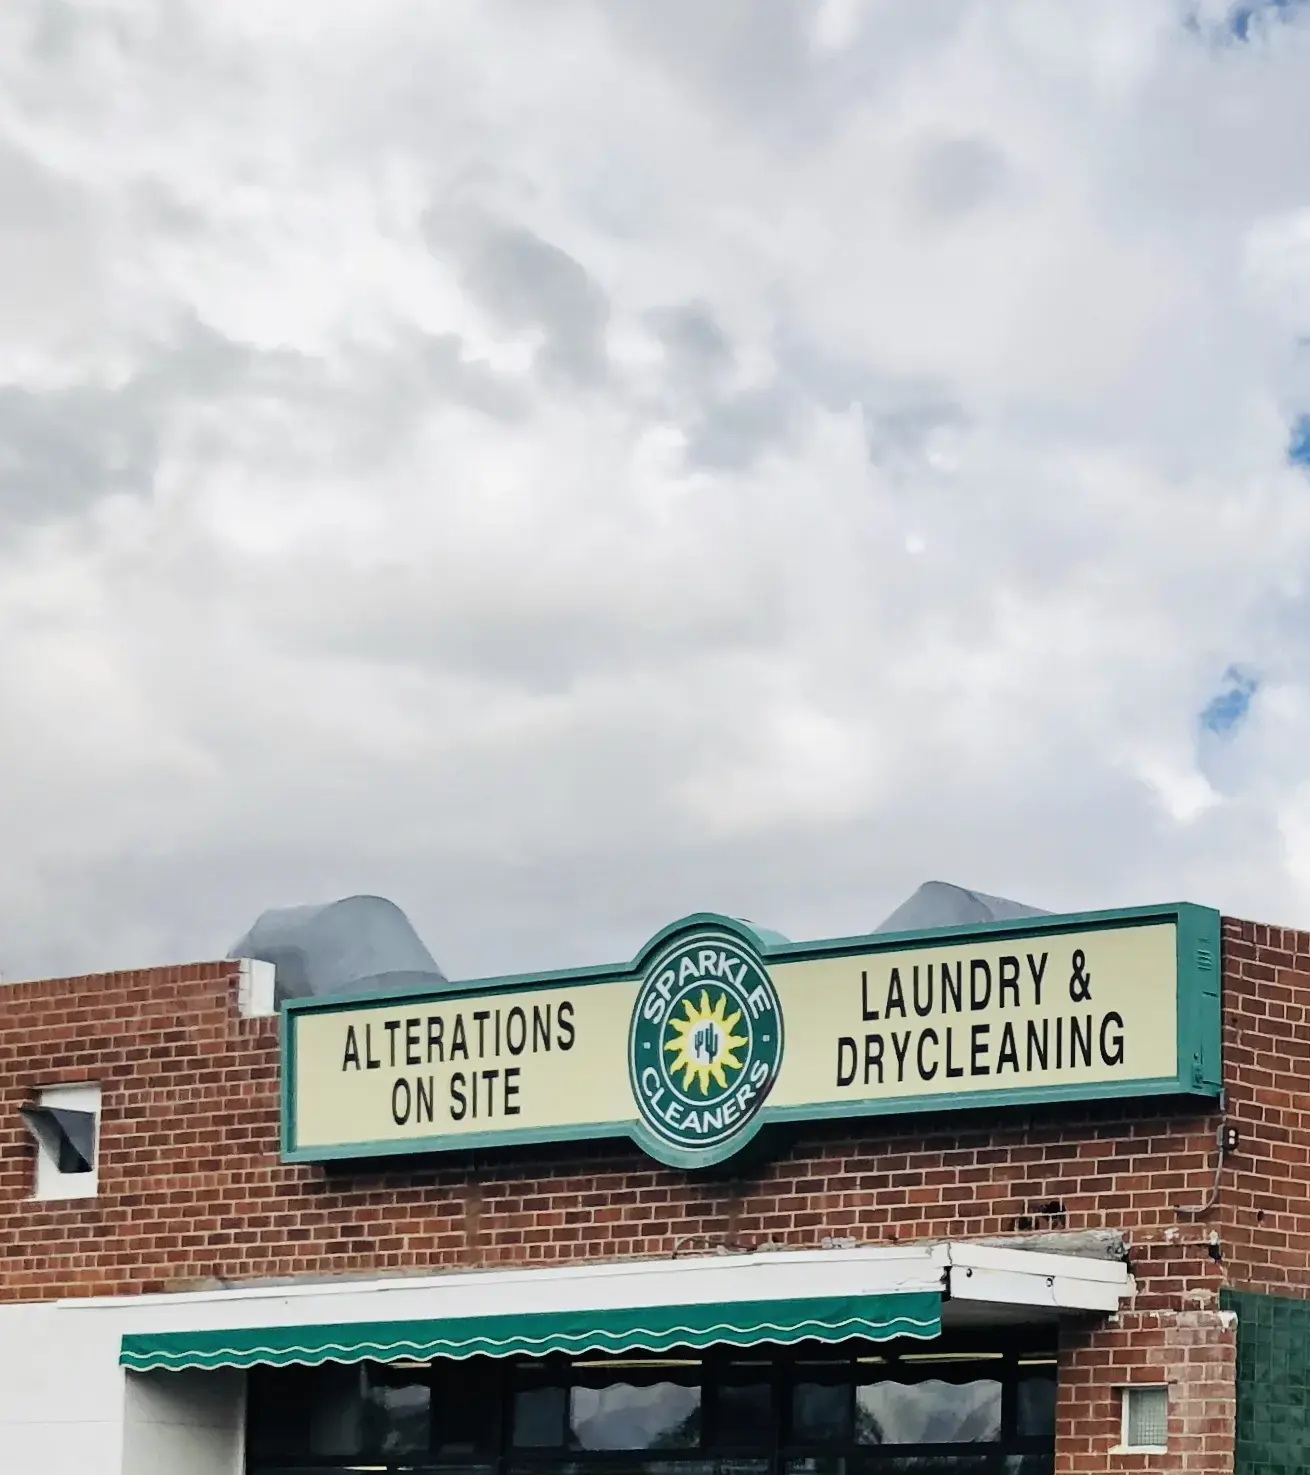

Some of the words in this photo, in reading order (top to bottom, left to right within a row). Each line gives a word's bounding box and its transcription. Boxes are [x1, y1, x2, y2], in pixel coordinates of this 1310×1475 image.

[643, 949, 771, 1025] SPARKLE
[861, 952, 1049, 1021] LAUNDRY
[1069, 949, 1092, 1003] &
[342, 1001, 576, 1072] ALTERATIONS
[836, 1011, 1124, 1087] DRYCLEANING
[391, 1075, 434, 1126] ON
[449, 1067, 521, 1121] SITE
[641, 1058, 770, 1133] CLEANERS
